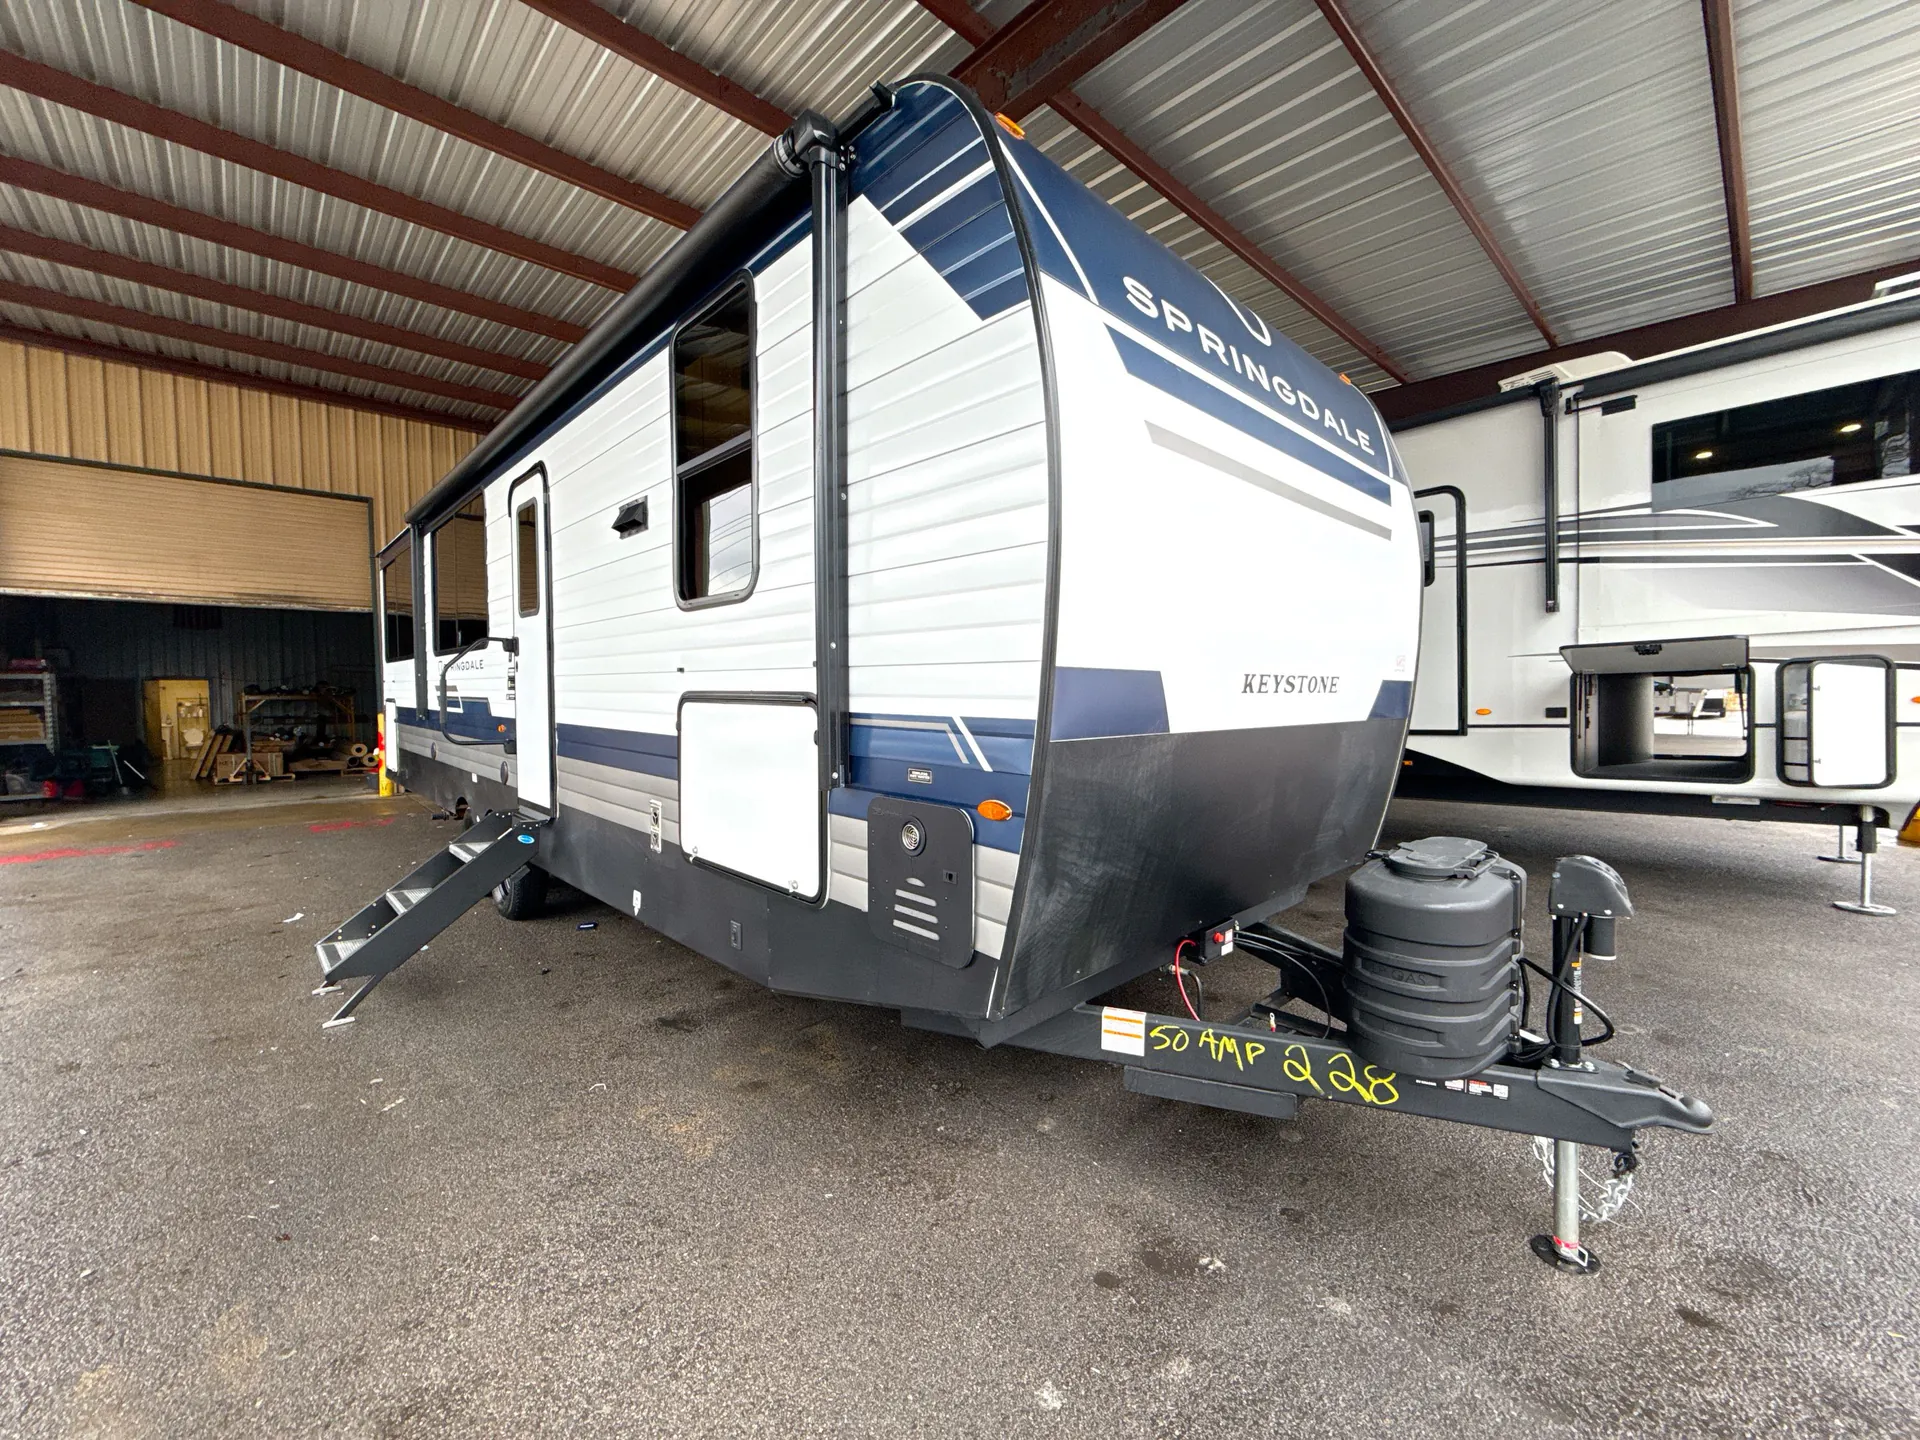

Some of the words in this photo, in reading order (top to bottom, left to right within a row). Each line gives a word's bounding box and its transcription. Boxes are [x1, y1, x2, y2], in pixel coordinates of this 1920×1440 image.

[1122, 276, 1375, 456] SPRINGDALE
[1241, 673, 1340, 694] KEYSTONE
[1391, 967, 1427, 986] GAS
[1149, 1025, 1189, 1052] 50
[1198, 1028, 1266, 1072] AMP
